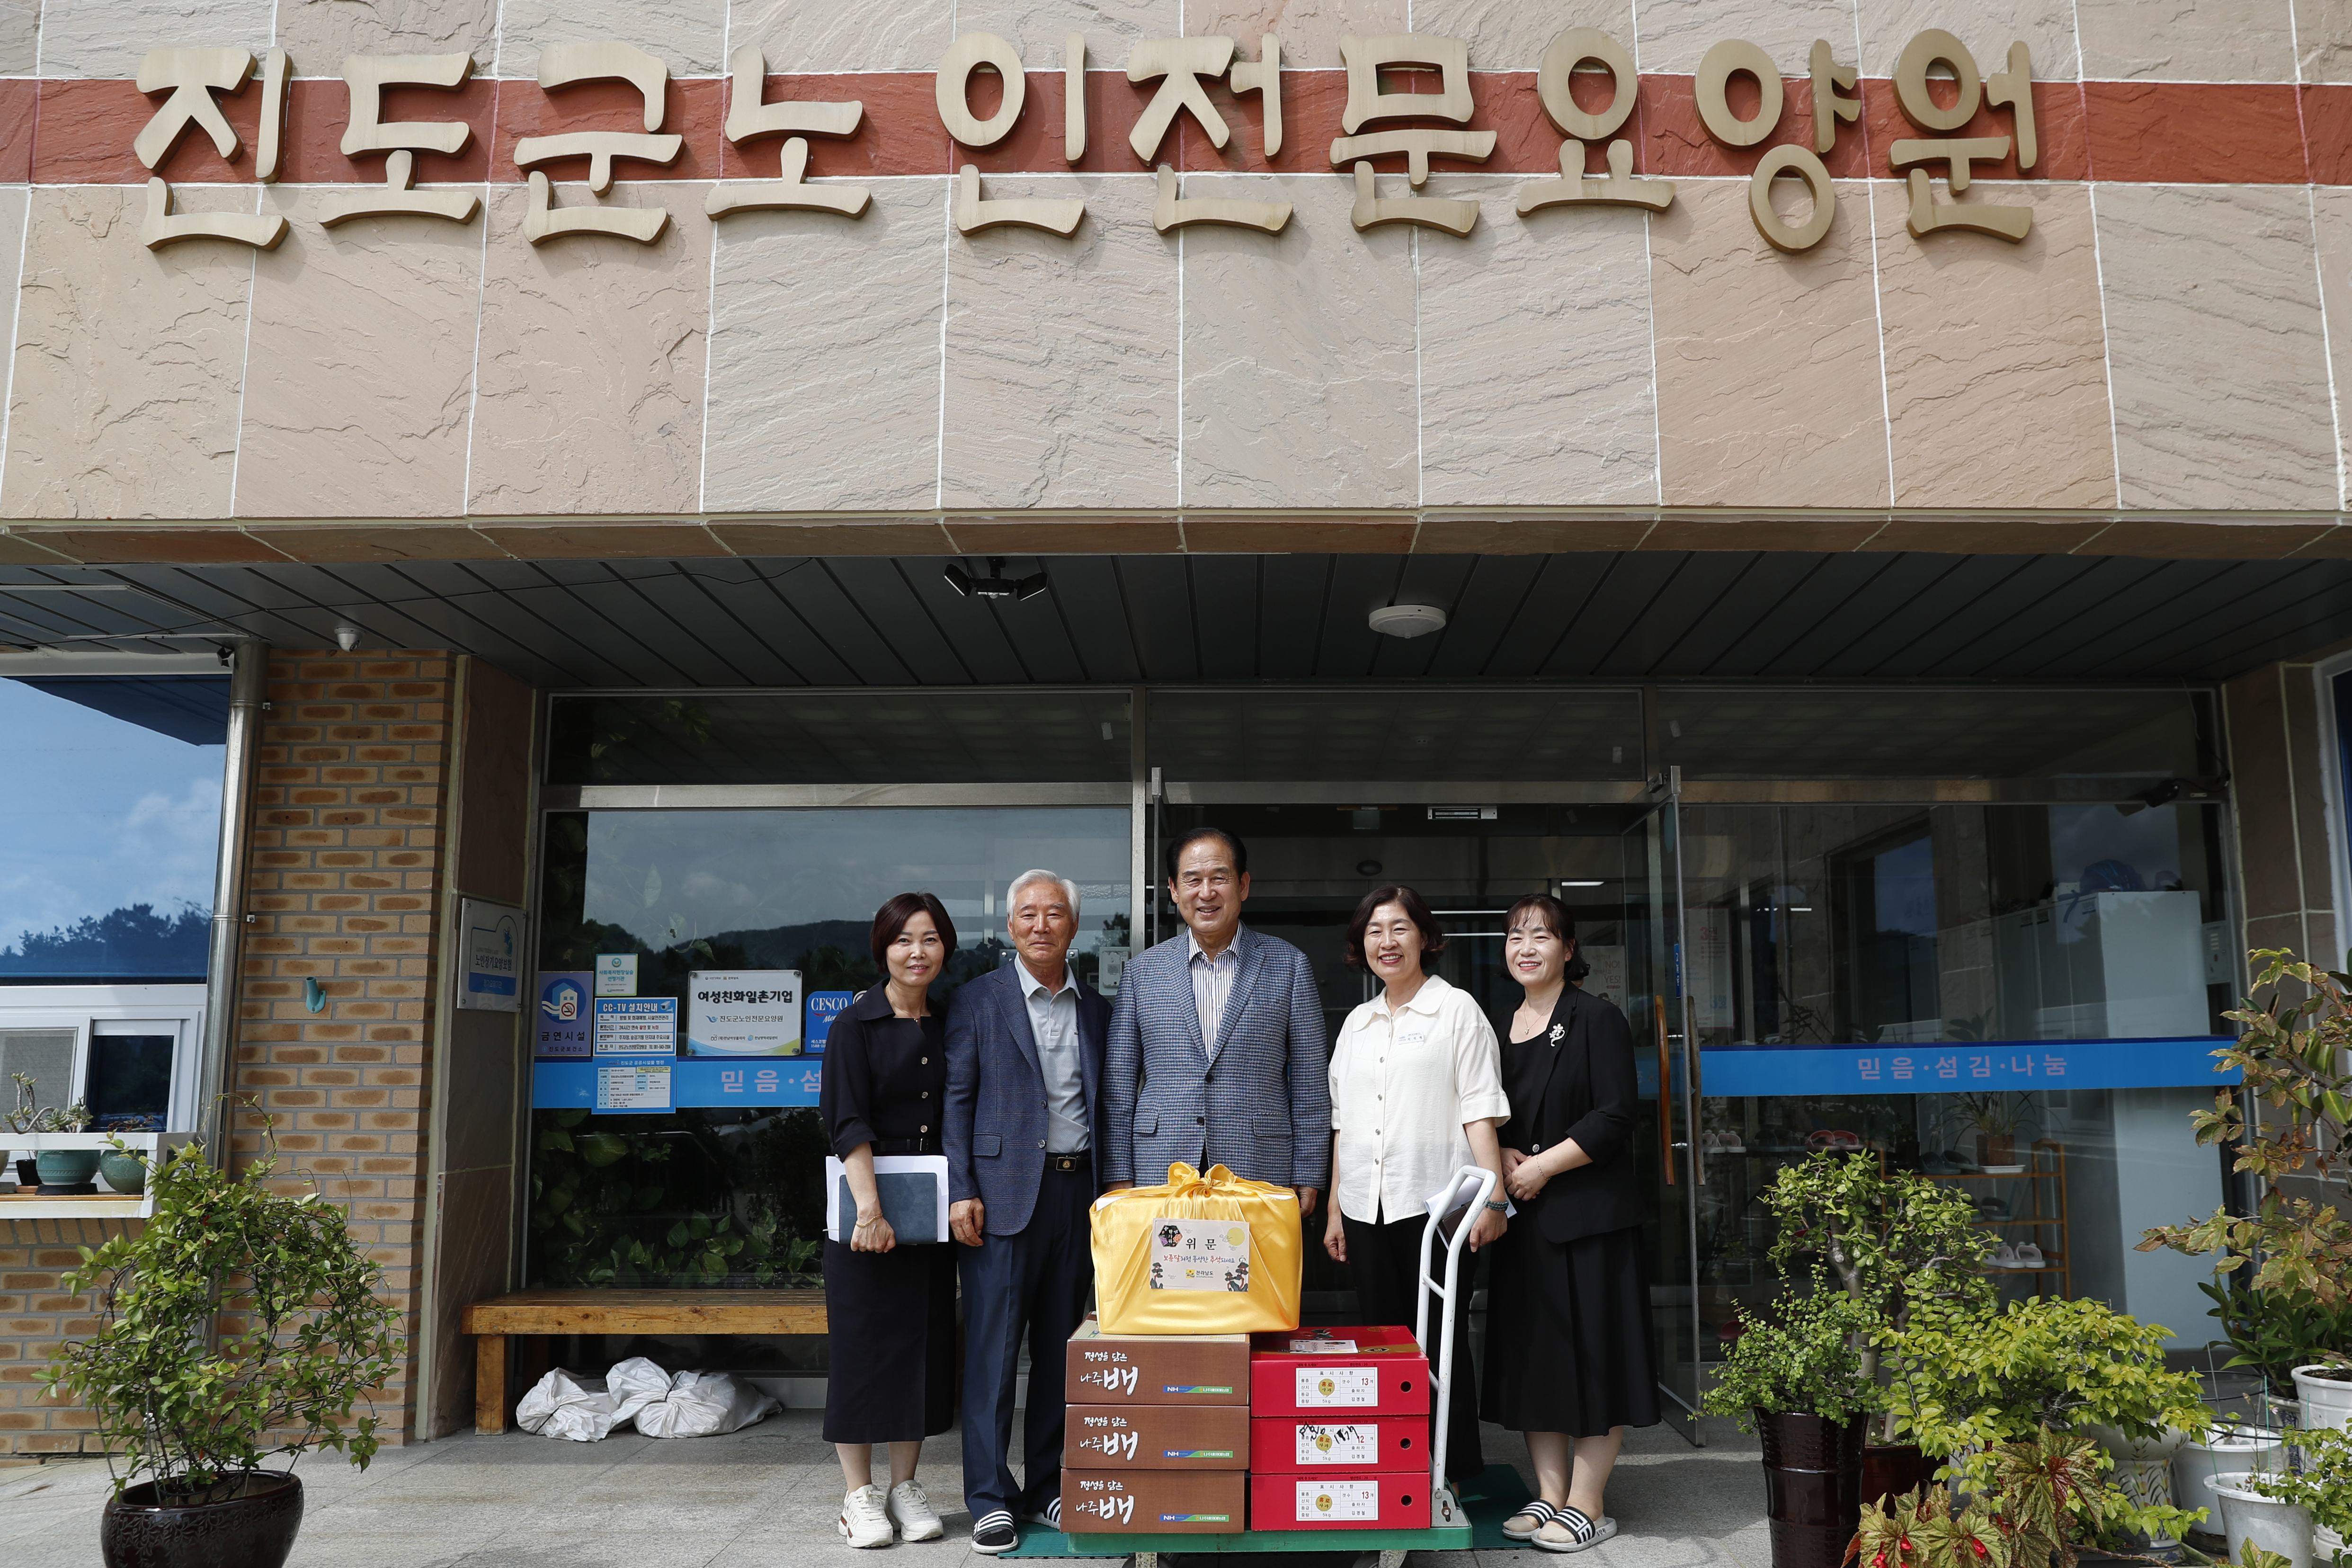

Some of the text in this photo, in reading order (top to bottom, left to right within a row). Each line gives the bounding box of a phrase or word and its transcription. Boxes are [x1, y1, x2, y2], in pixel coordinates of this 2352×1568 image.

[134, 26, 2039, 254] 진도군노인전문요양원
[475, 954, 512, 971] 노인장기요양보험
[1604, 975, 1621, 983] YES!
[698, 990, 793, 1004] 여성친화일촌기업
[603, 1003, 658, 1012] CC-TV 설치안내
[811, 997, 848, 1011] CESCO
[541, 1031, 585, 1041] 금연시설
[1185, 1238, 1217, 1250] 위문
[1164, 1254, 1191, 1263] 보름달처럼
[1210, 1255, 1235, 1264] 추석되세요
[1085, 1351, 1128, 1362] 정성을 담은
[1361, 1378, 1369, 1386] 13
[1084, 1416, 1127, 1427] 정성을 담은
[1080, 1480, 1123, 1491] 정성을 담은
[1362, 1491, 1369, 1499] 13
